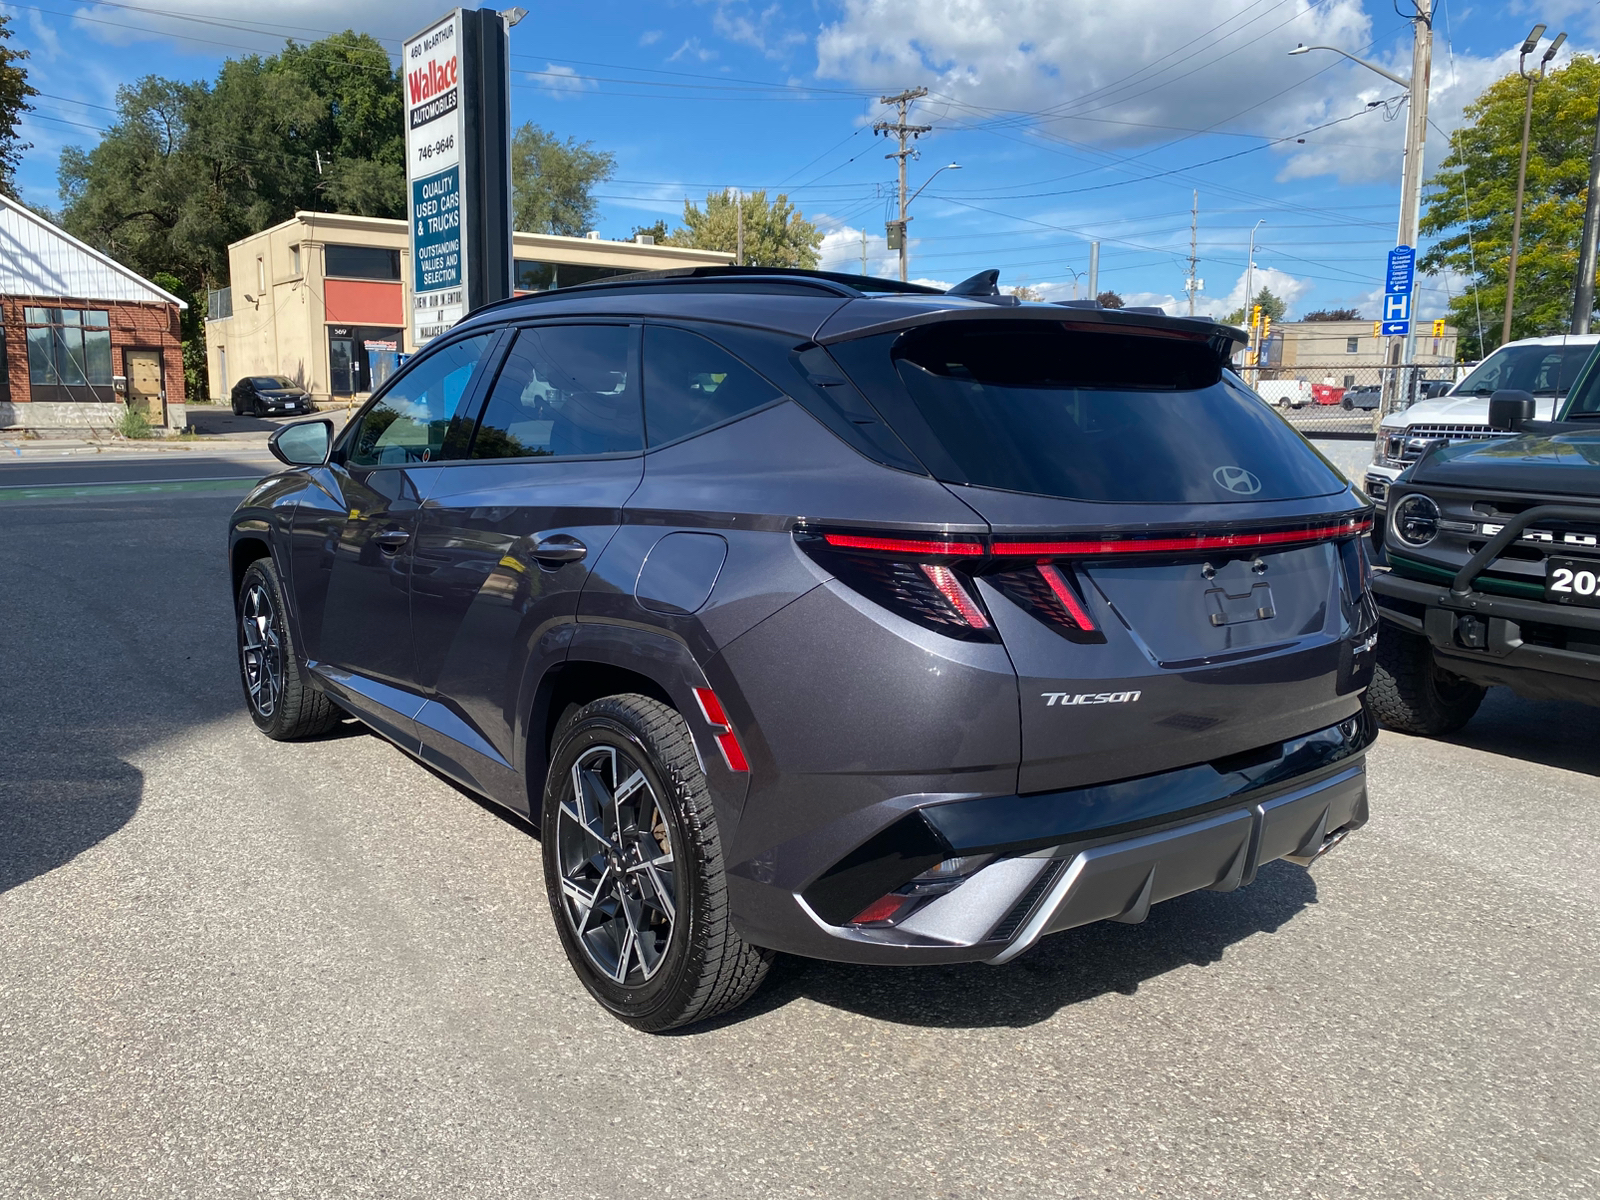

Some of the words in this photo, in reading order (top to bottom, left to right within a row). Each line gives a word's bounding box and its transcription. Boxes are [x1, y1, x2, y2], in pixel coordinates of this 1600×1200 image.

[411, 43, 422, 59] 460
[423, 24, 454, 52] McARTHUR
[408, 55, 458, 105] Wallace
[413, 91, 457, 126] AUTOMOBILES
[418, 134, 454, 161] 746-9646
[422, 175, 453, 199] QUALITY
[416, 200, 438, 218] USED
[440, 191, 459, 211] CARS
[417, 221, 424, 236] &
[428, 210, 459, 234] TRUCKS
[418, 239, 459, 259] OUTSTANDING
[421, 257, 444, 272] VALUES
[445, 254, 458, 267] AND
[423, 268, 456, 285] SELECTION
[1387, 296, 1407, 319] H
